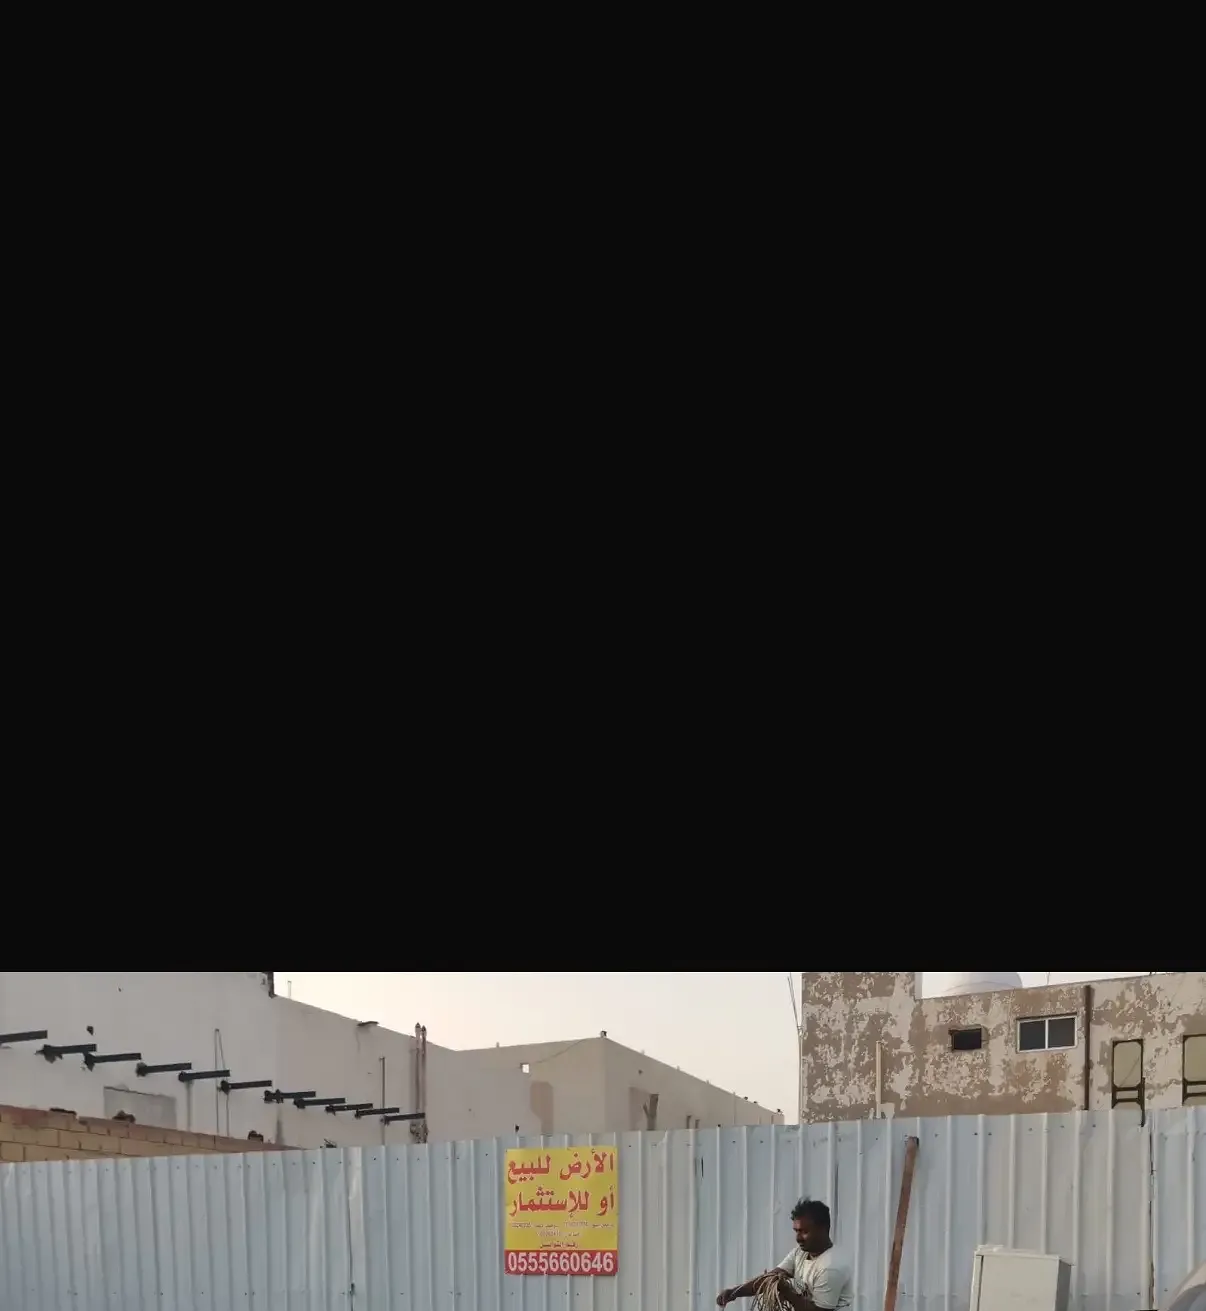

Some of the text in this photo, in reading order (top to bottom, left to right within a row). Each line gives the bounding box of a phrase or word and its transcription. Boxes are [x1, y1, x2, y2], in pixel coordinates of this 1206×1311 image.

[507, 1148, 614, 1185] الأرض للبيع
[508, 1185, 615, 1218] أو للإستثمار
[507, 1251, 614, 1273] 0555660646
